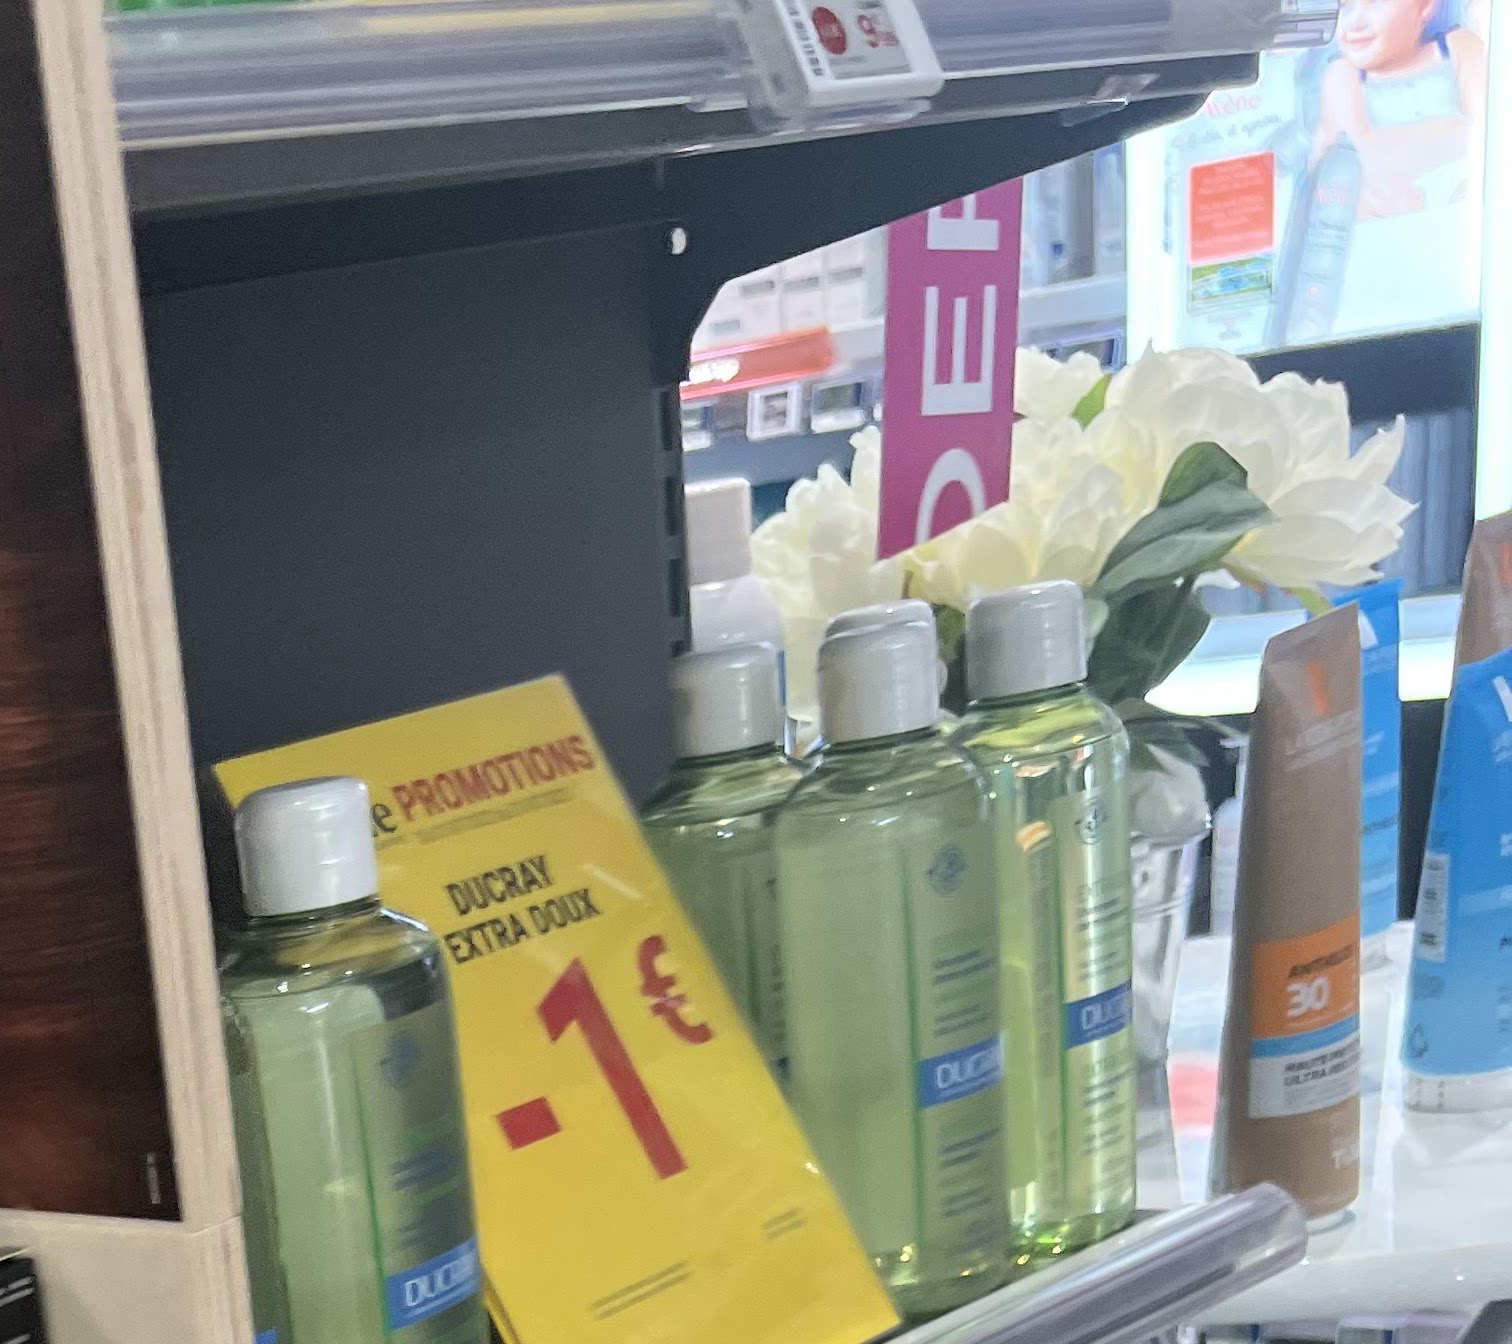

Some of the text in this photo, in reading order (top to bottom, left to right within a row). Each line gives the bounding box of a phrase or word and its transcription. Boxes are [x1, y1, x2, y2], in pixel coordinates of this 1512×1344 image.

[392, 734, 595, 822] PROMOTIONS
[444, 855, 554, 917] DUCRAY
[444, 888, 602, 965] EXTRA DOUX
[1286, 976, 1330, 1018] 30
